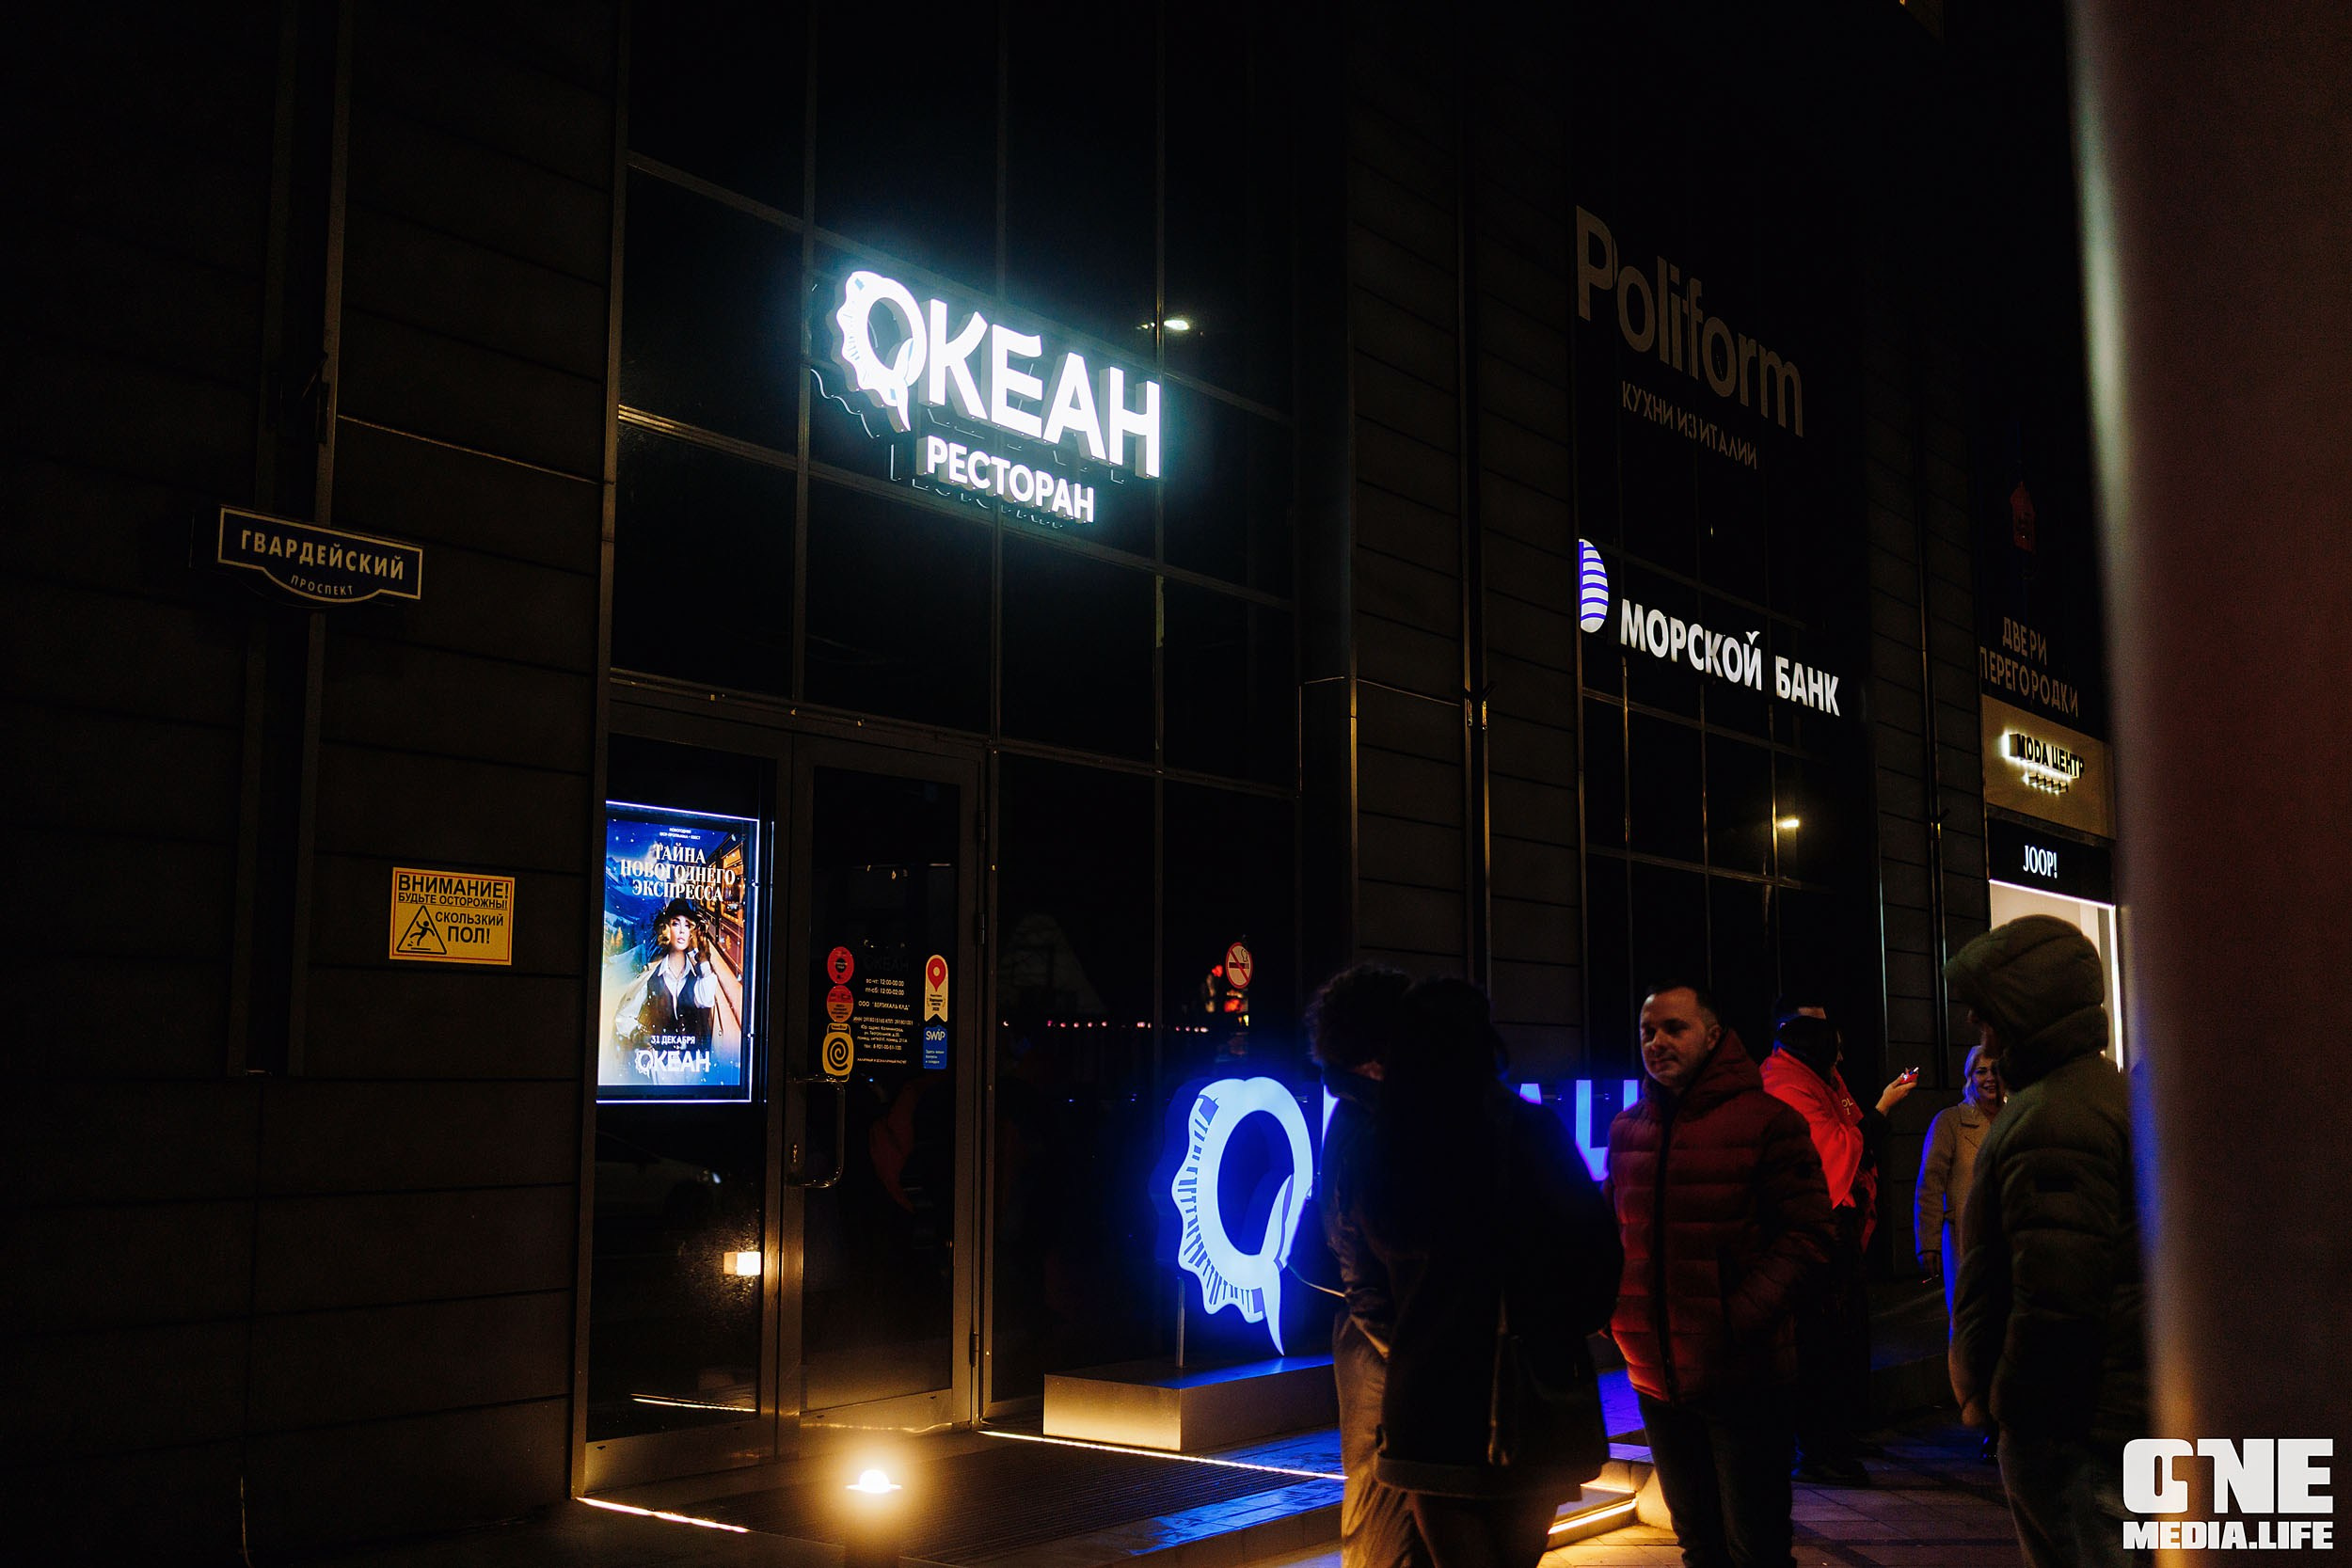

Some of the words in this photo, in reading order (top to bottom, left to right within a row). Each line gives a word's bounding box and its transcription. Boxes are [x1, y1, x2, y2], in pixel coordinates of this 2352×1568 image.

[1575, 204, 1804, 437] Poliform
[836, 270, 1160, 479] ОКЕАН
[1621, 379, 1674, 429] КУХНИ
[1677, 405, 1697, 441] ИЗ
[1698, 418, 1760, 470] ИТАЛИИ
[927, 435, 1094, 524] РЕСТОРАН
[241, 529, 405, 580] ГВАРДЕЙСКИЙ
[290, 574, 354, 595] ПРОСПЕКТ
[2002, 616, 2048, 666] ДВЕРИ
[1620, 597, 1762, 691] МОРСКОЙ
[1775, 655, 1841, 717] БАНК
[1979, 645, 2079, 719] ПЕРЕГОРОДКИ
[652, 842, 706, 864] ТАЙНА
[2023, 845, 2058, 879] JOOP!
[398, 874, 508, 899] ВНИМАНИЕ!
[620, 859, 736, 886] НОВОГОДНЕГО
[398, 892, 437, 904] БУДЬТЕ
[439, 895, 507, 909] ОСТОРОЖНЫ!
[631, 879, 723, 902] ЭКСПРЕССА
[435, 911, 503, 927] СКОЛЬЗКИЙ
[448, 926, 490, 943] ПОЛ!
[650, 1036, 660, 1044] 31
[661, 1036, 696, 1046] ДЕКАБРЯ
[634, 1049, 711, 1078] ОКЕАН
